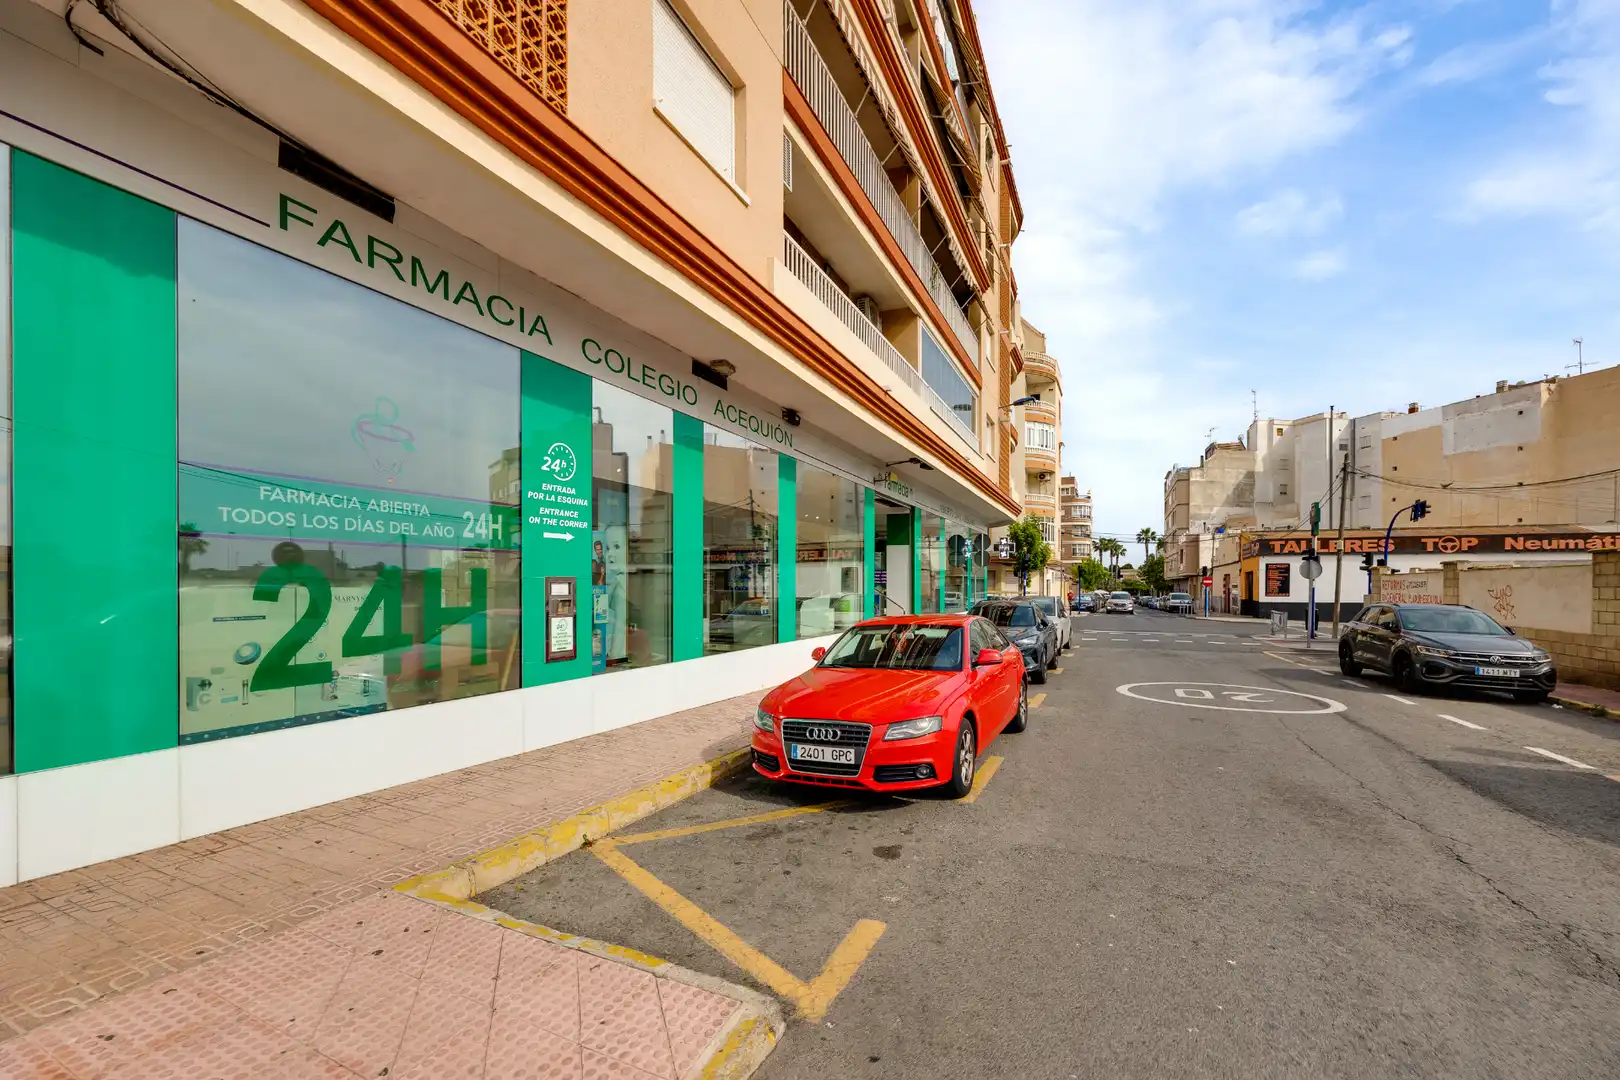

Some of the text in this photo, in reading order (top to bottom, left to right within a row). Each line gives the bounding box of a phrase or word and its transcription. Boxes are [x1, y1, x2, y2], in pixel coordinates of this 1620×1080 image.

[279, 192, 793, 448] FARMACIA COLEGIO ACEQUIÓN
[540, 456, 567, 473] 24h
[541, 483, 576, 495] ENTRADA
[259, 486, 431, 517] FARMACIA ABIERTA
[527, 491, 588, 506] POR LA ESQUINA
[539, 507, 579, 518] ENTRANCE
[218, 506, 455, 539] TODOS LOS DÍAS DEL AÑO
[462, 510, 503, 542] 24H
[528, 516, 588, 529] ON THE CORNER
[1421, 535, 1478, 554] TOP
[250, 561, 488, 693] 24H
[800, 746, 853, 762] 2401 GPC
